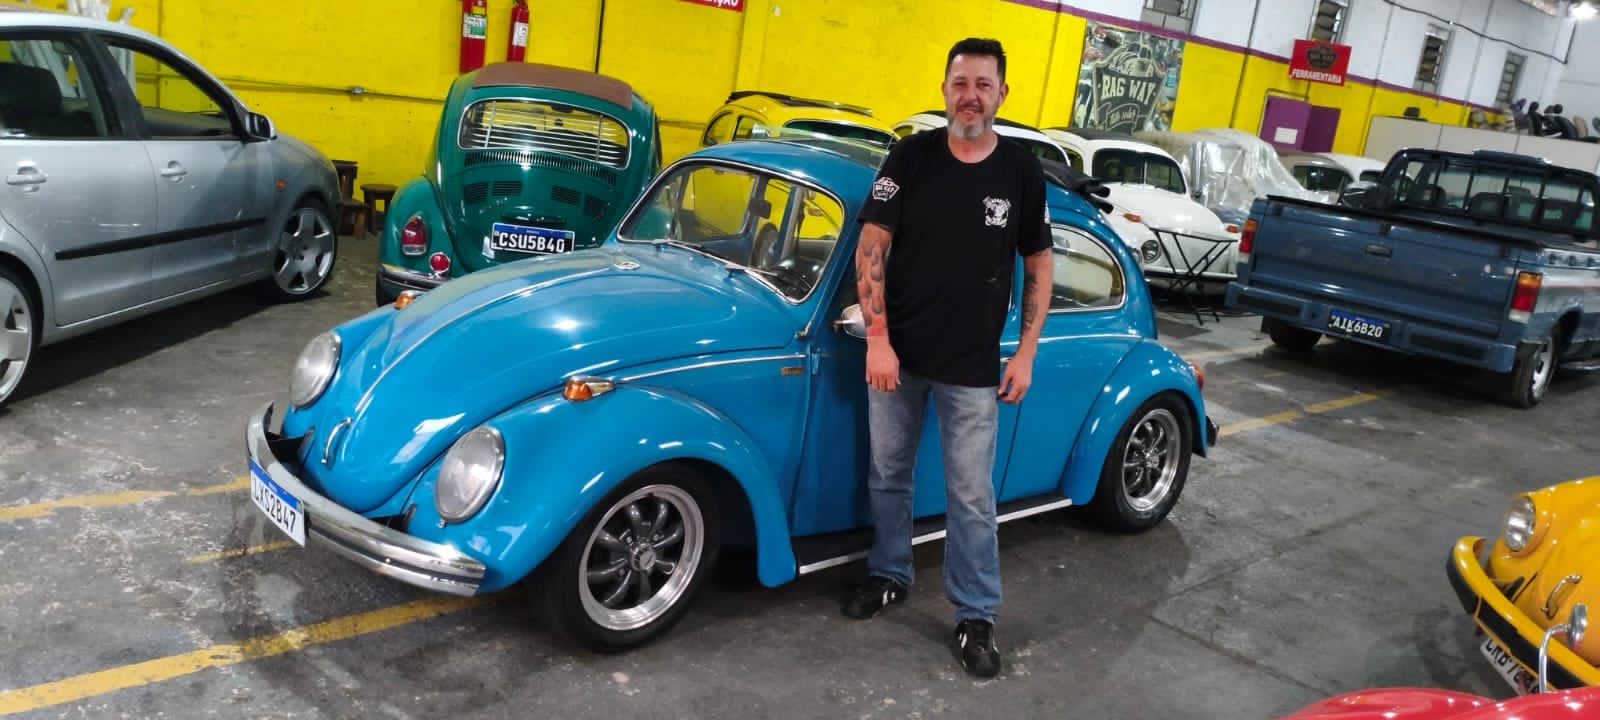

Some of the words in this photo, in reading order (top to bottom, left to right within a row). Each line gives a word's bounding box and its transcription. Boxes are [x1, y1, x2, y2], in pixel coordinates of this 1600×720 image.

[1291, 69, 1342, 84] FERRAMENTARIA
[1101, 75, 1126, 101] RAG
[1129, 79, 1157, 105] WAY
[499, 232, 565, 253] CSU5B40
[1332, 316, 1383, 338] AIK6B20
